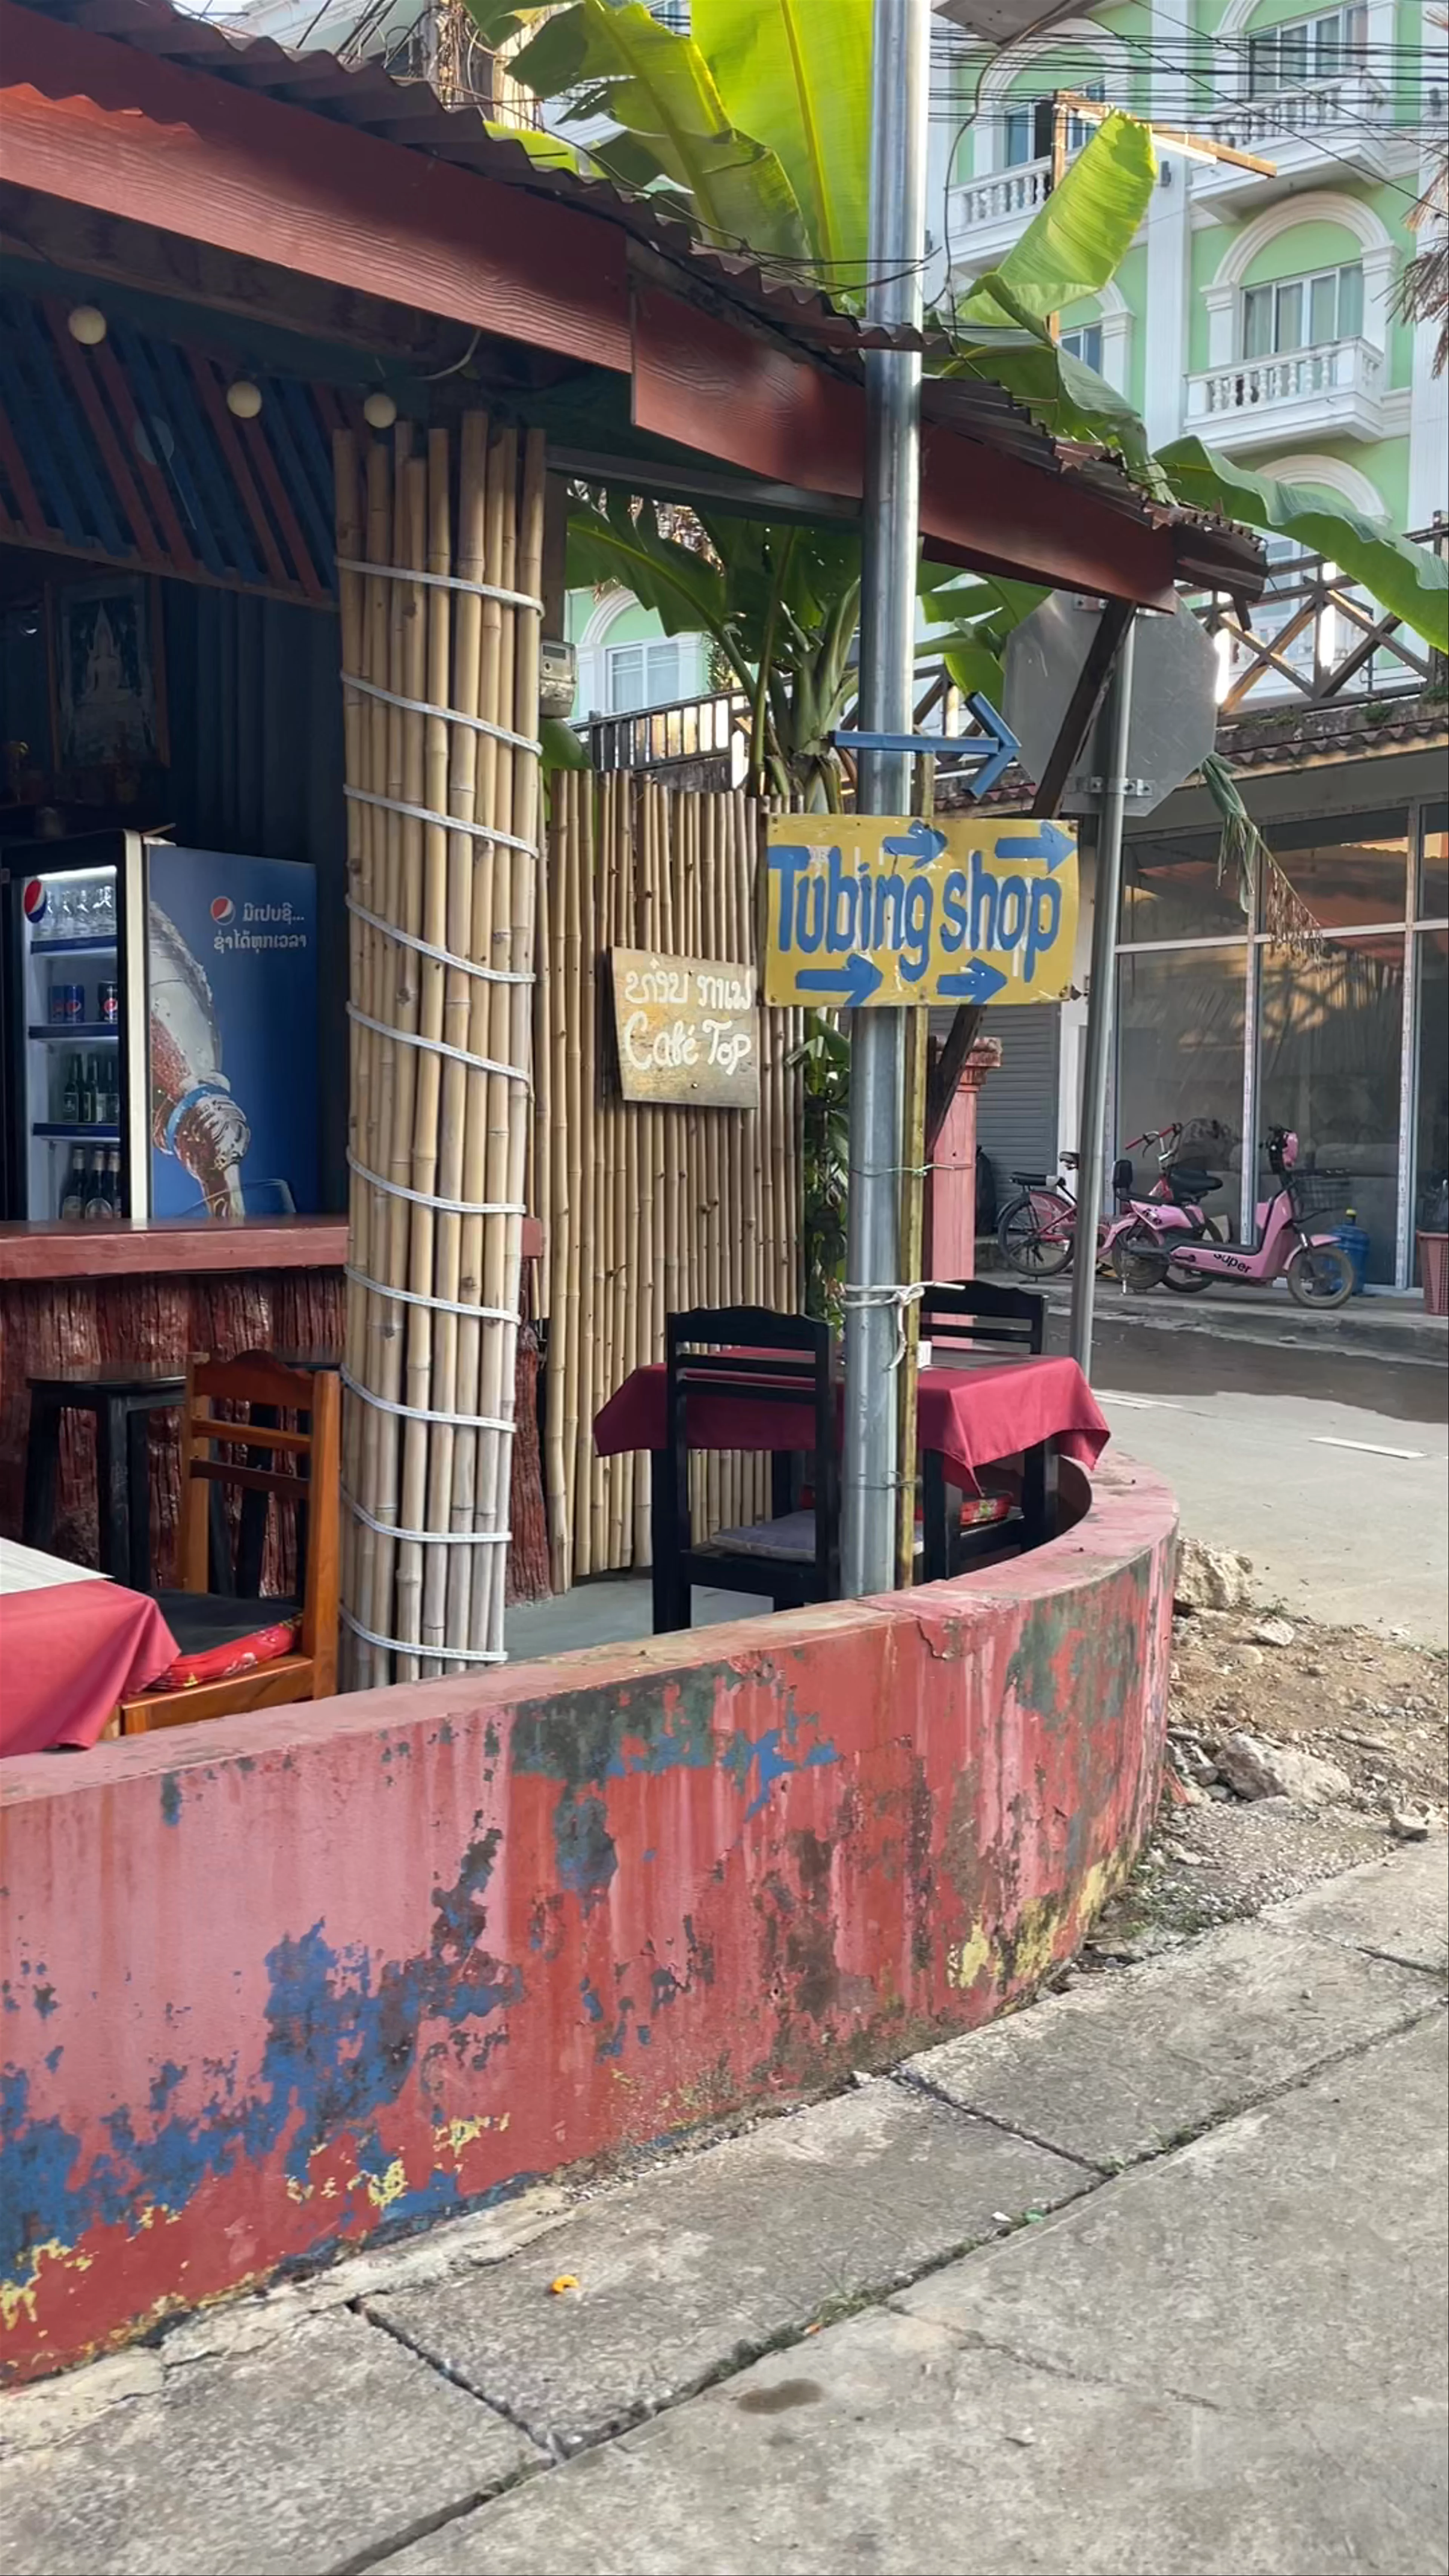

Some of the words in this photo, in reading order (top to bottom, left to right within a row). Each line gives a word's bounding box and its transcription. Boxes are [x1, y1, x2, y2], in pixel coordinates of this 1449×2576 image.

[768, 844, 933, 983] Tubing
[940, 850, 1062, 983] shop
[625, 1010, 699, 1070] Café
